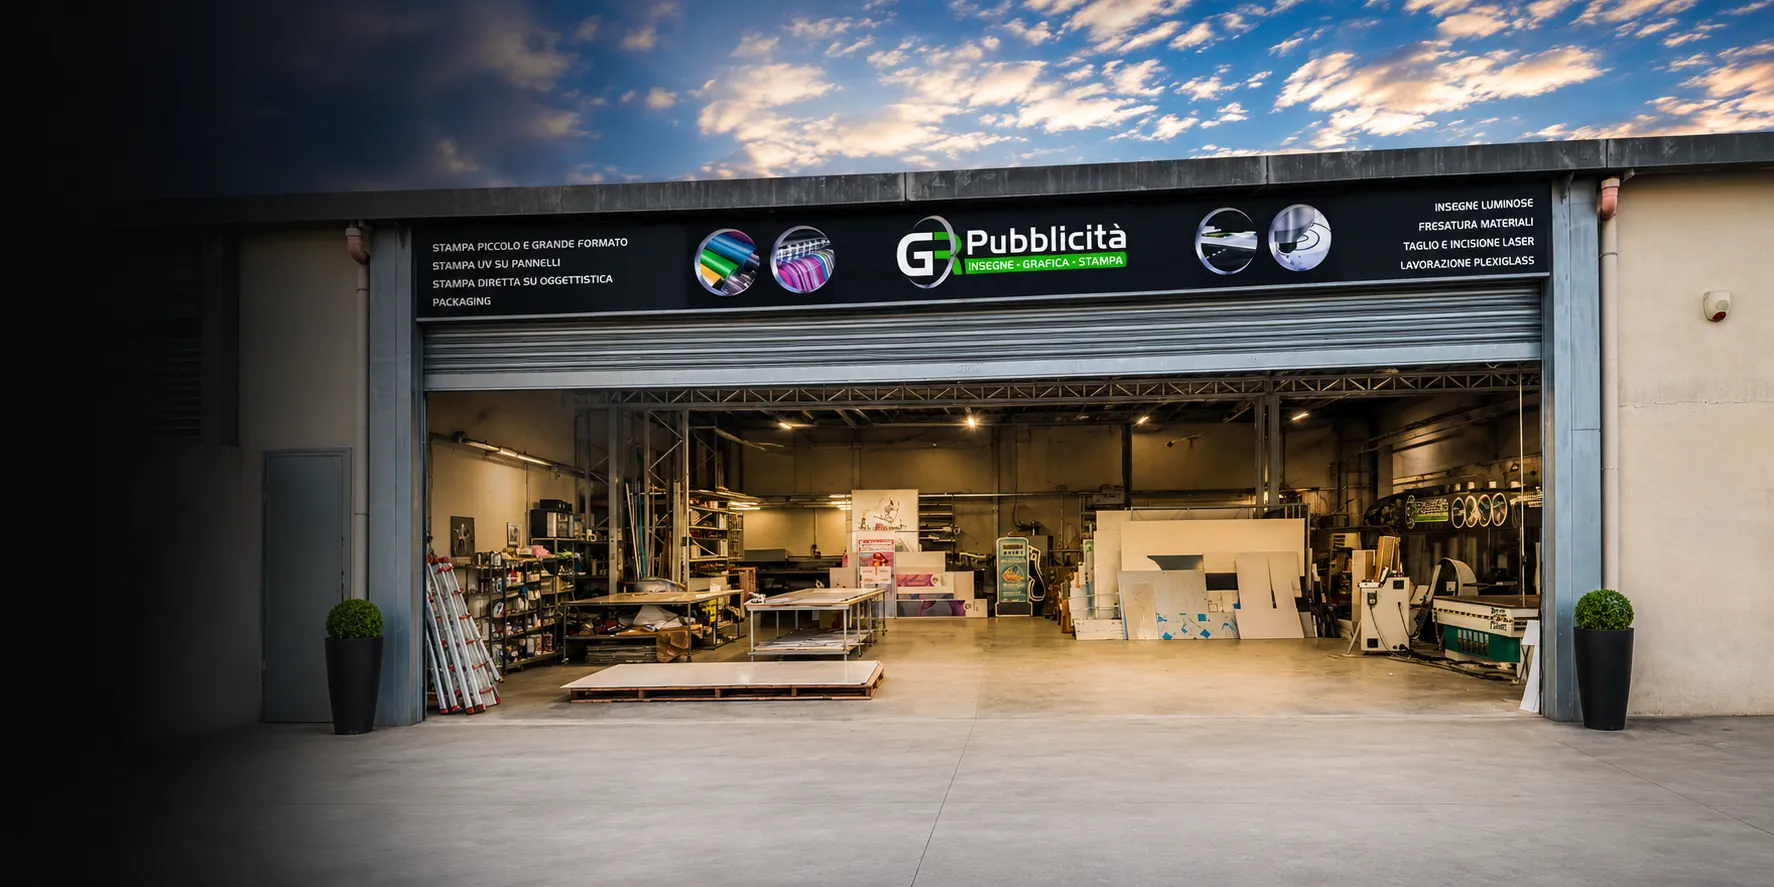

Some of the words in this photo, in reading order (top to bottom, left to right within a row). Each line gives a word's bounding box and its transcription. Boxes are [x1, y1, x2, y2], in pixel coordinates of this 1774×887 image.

[1435, 201, 1478, 212] INSEGNE
[1482, 198, 1533, 209] LUMINOSE
[1419, 220, 1478, 231] FRESATURA
[1481, 218, 1533, 228] MATERIALI
[432, 243, 475, 253] STAMPA
[478, 242, 520, 252] PICCOLO
[523, 241, 529, 251] E
[532, 240, 574, 250] GRANDE
[578, 238, 628, 248] FORMATO
[967, 224, 1127, 255] Pubblicità
[1403, 241, 1439, 250] TAGLIO
[1441, 241, 1448, 249] E
[1450, 238, 1500, 249] INCISIONE
[1503, 237, 1534, 246] LASER
[432, 261, 475, 271] STAMPA
[478, 260, 492, 269] UV
[495, 260, 508, 269] SU
[512, 258, 560, 268] PANNELLI
[968, 261, 1015, 271] INSEGNE
[1022, 259, 1070, 269] GRAFICA
[1078, 256, 1124, 267] STAMPA
[1401, 258, 1471, 269] LAVORAZIONE
[1474, 256, 1534, 266] PLEXIGLASS
[432, 279, 475, 289] STAMPA
[478, 278, 520, 288] DIRETTA
[524, 277, 537, 286] SU
[540, 275, 613, 286] OGGETTISTICA
[432, 297, 491, 307] PACKAGING
